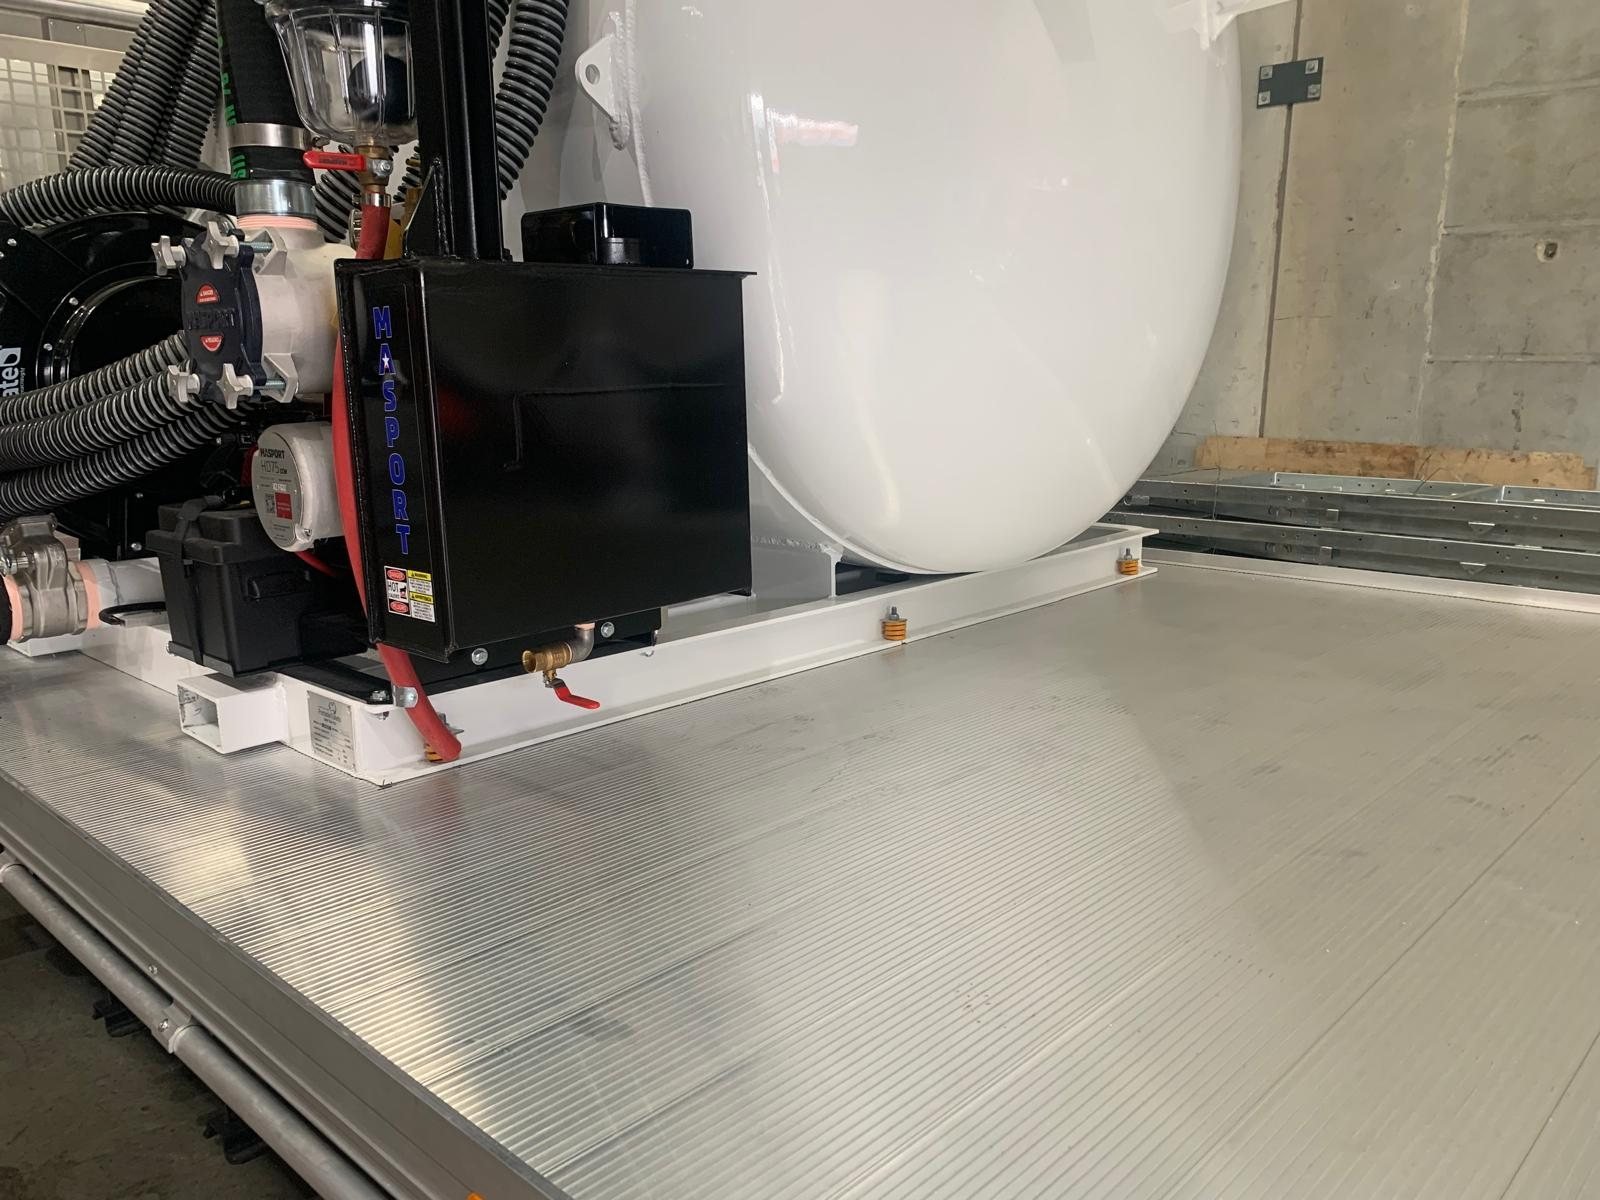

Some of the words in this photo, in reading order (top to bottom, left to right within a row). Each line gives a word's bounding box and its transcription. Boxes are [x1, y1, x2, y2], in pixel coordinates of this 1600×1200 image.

[372, 305, 411, 555] MASPORT
[260, 448, 285, 459] MASPORT
[387, 581, 399, 592] HOT
